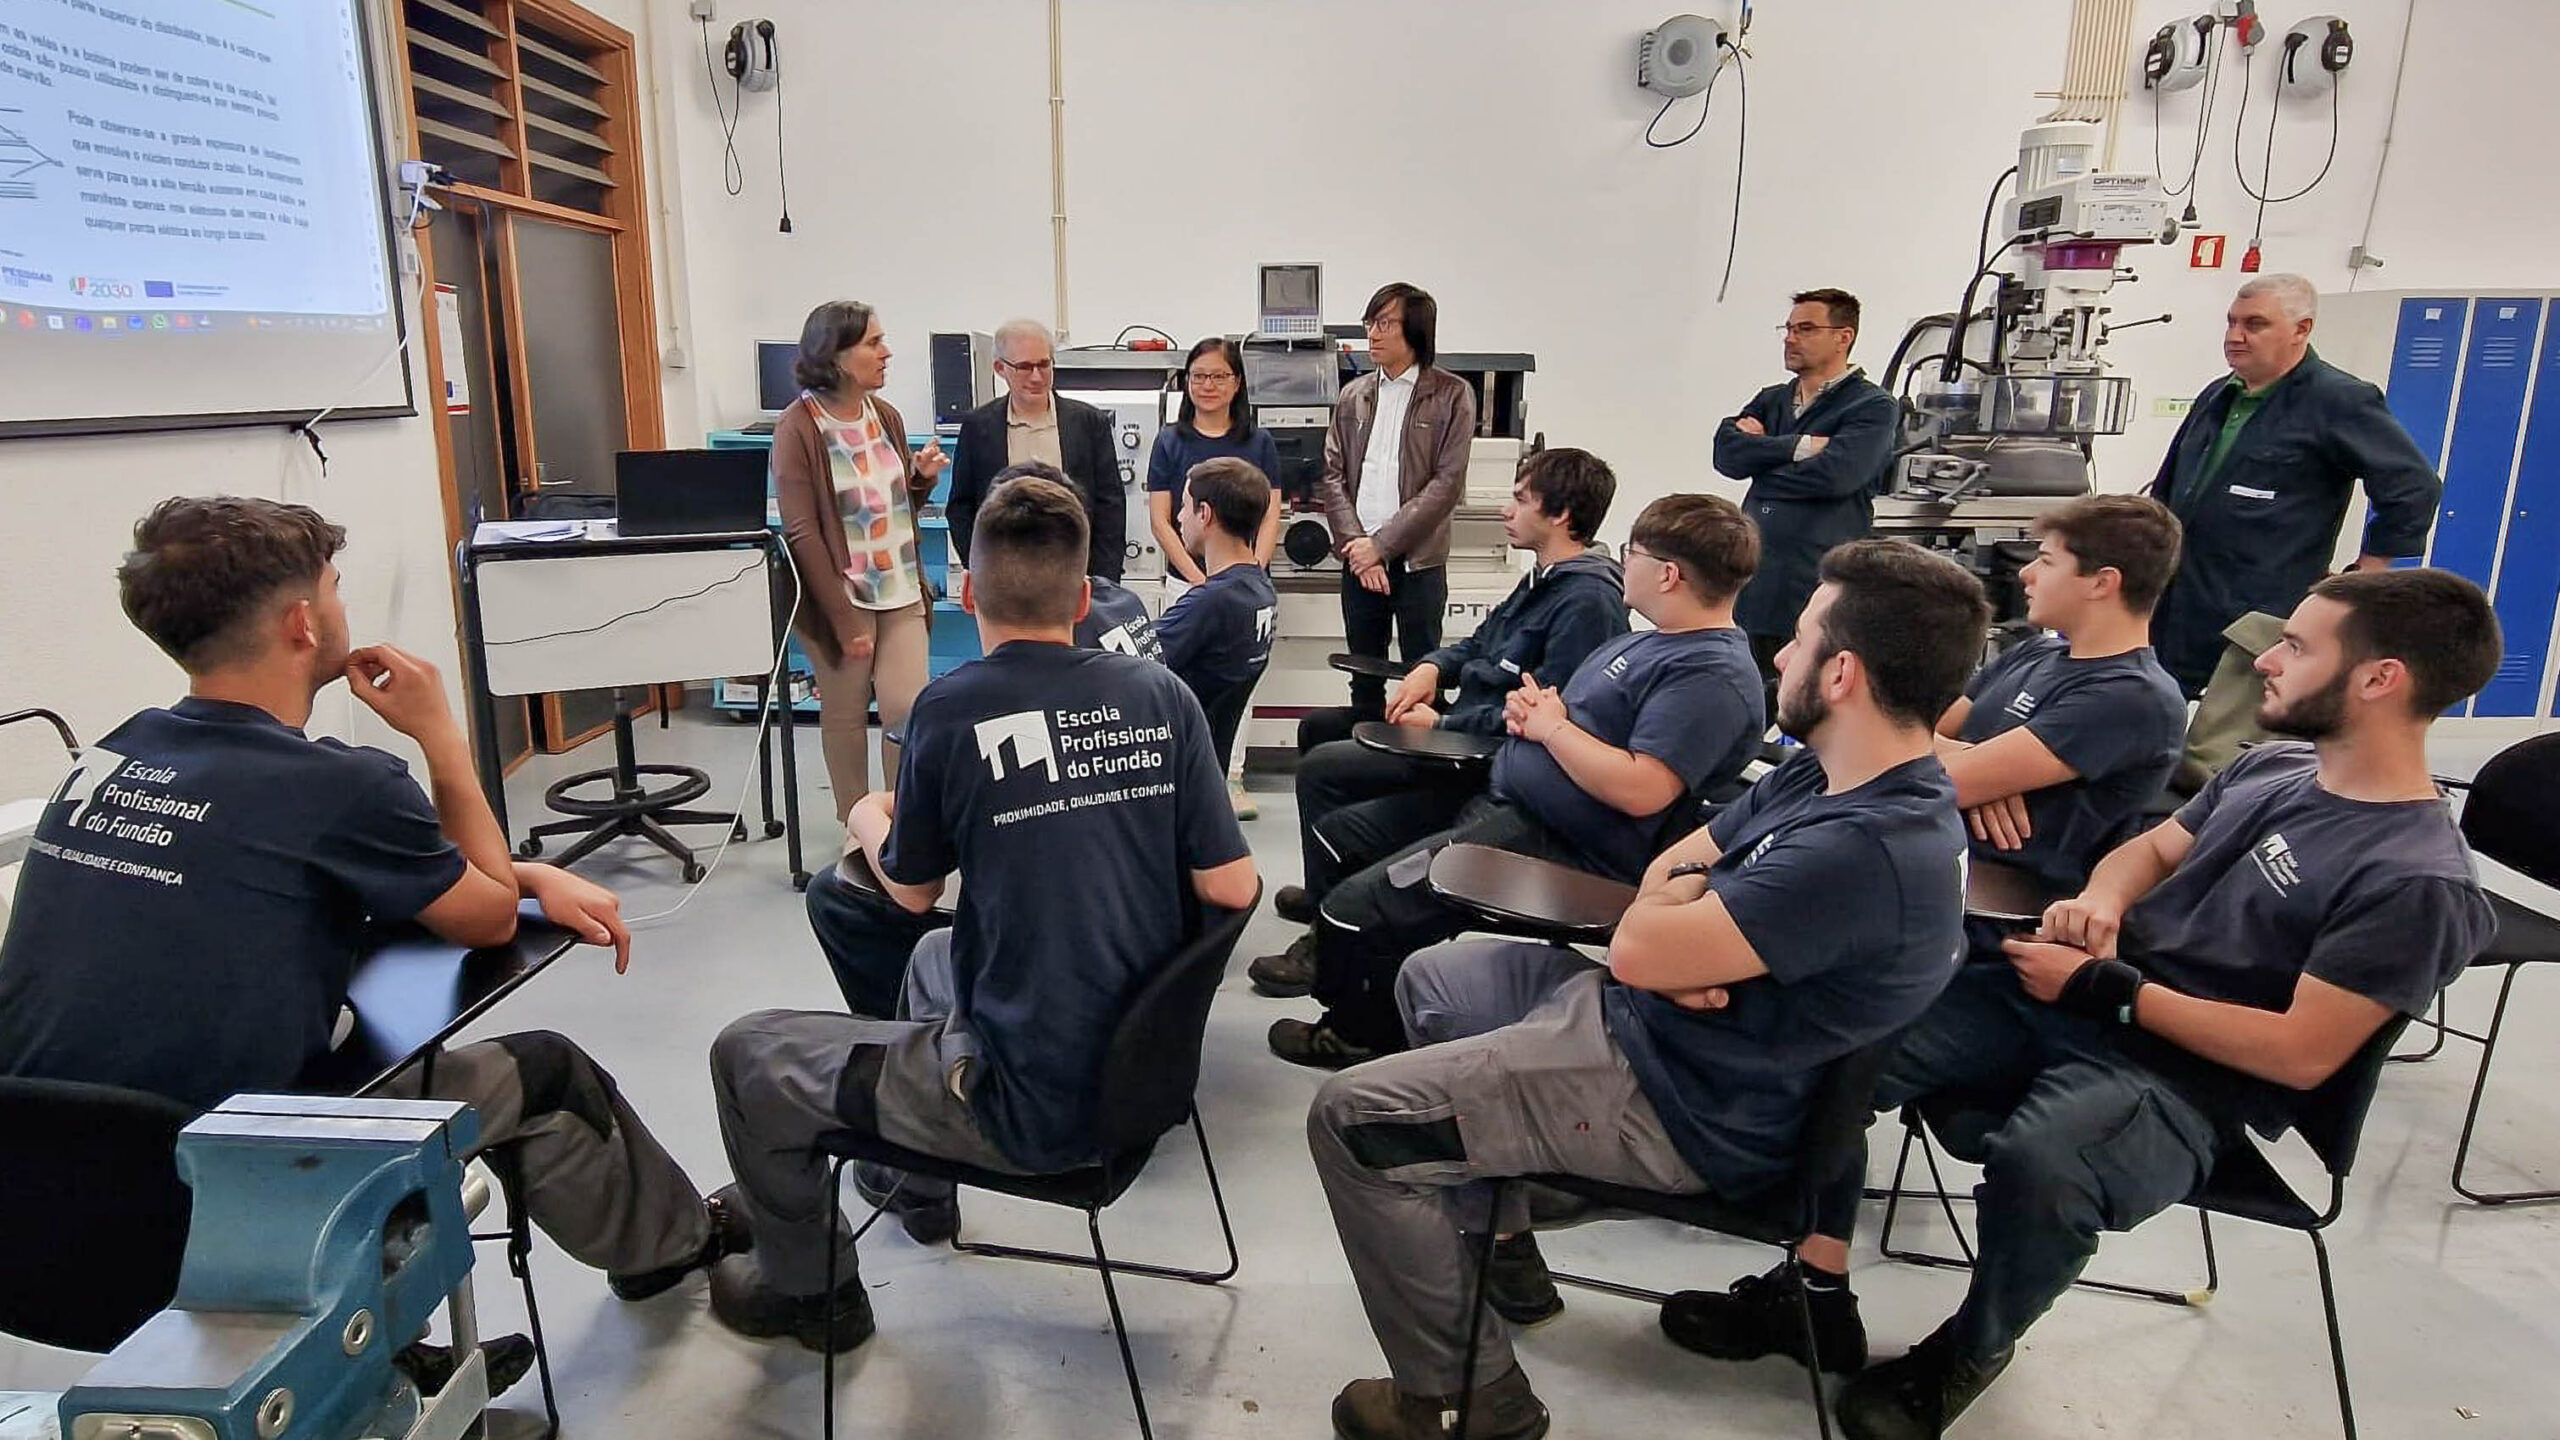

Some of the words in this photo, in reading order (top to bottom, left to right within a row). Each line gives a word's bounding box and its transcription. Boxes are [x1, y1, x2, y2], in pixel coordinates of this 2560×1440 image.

[90, 282, 133, 299] 2030
[1056, 705, 1121, 729] Escola
[1060, 720, 1173, 754] Profissional
[119, 759, 179, 785] Escola
[1066, 759, 1091, 780] do
[1093, 750, 1163, 777] Fundão
[101, 782, 213, 823] Profissional
[992, 798, 1070, 828] PROXIMIDADE,
[1130, 781, 1176, 799] CONFIAN
[84, 811, 104, 833] do
[106, 815, 174, 847] Fundão
[116, 861, 184, 886] CONFIANÇA
